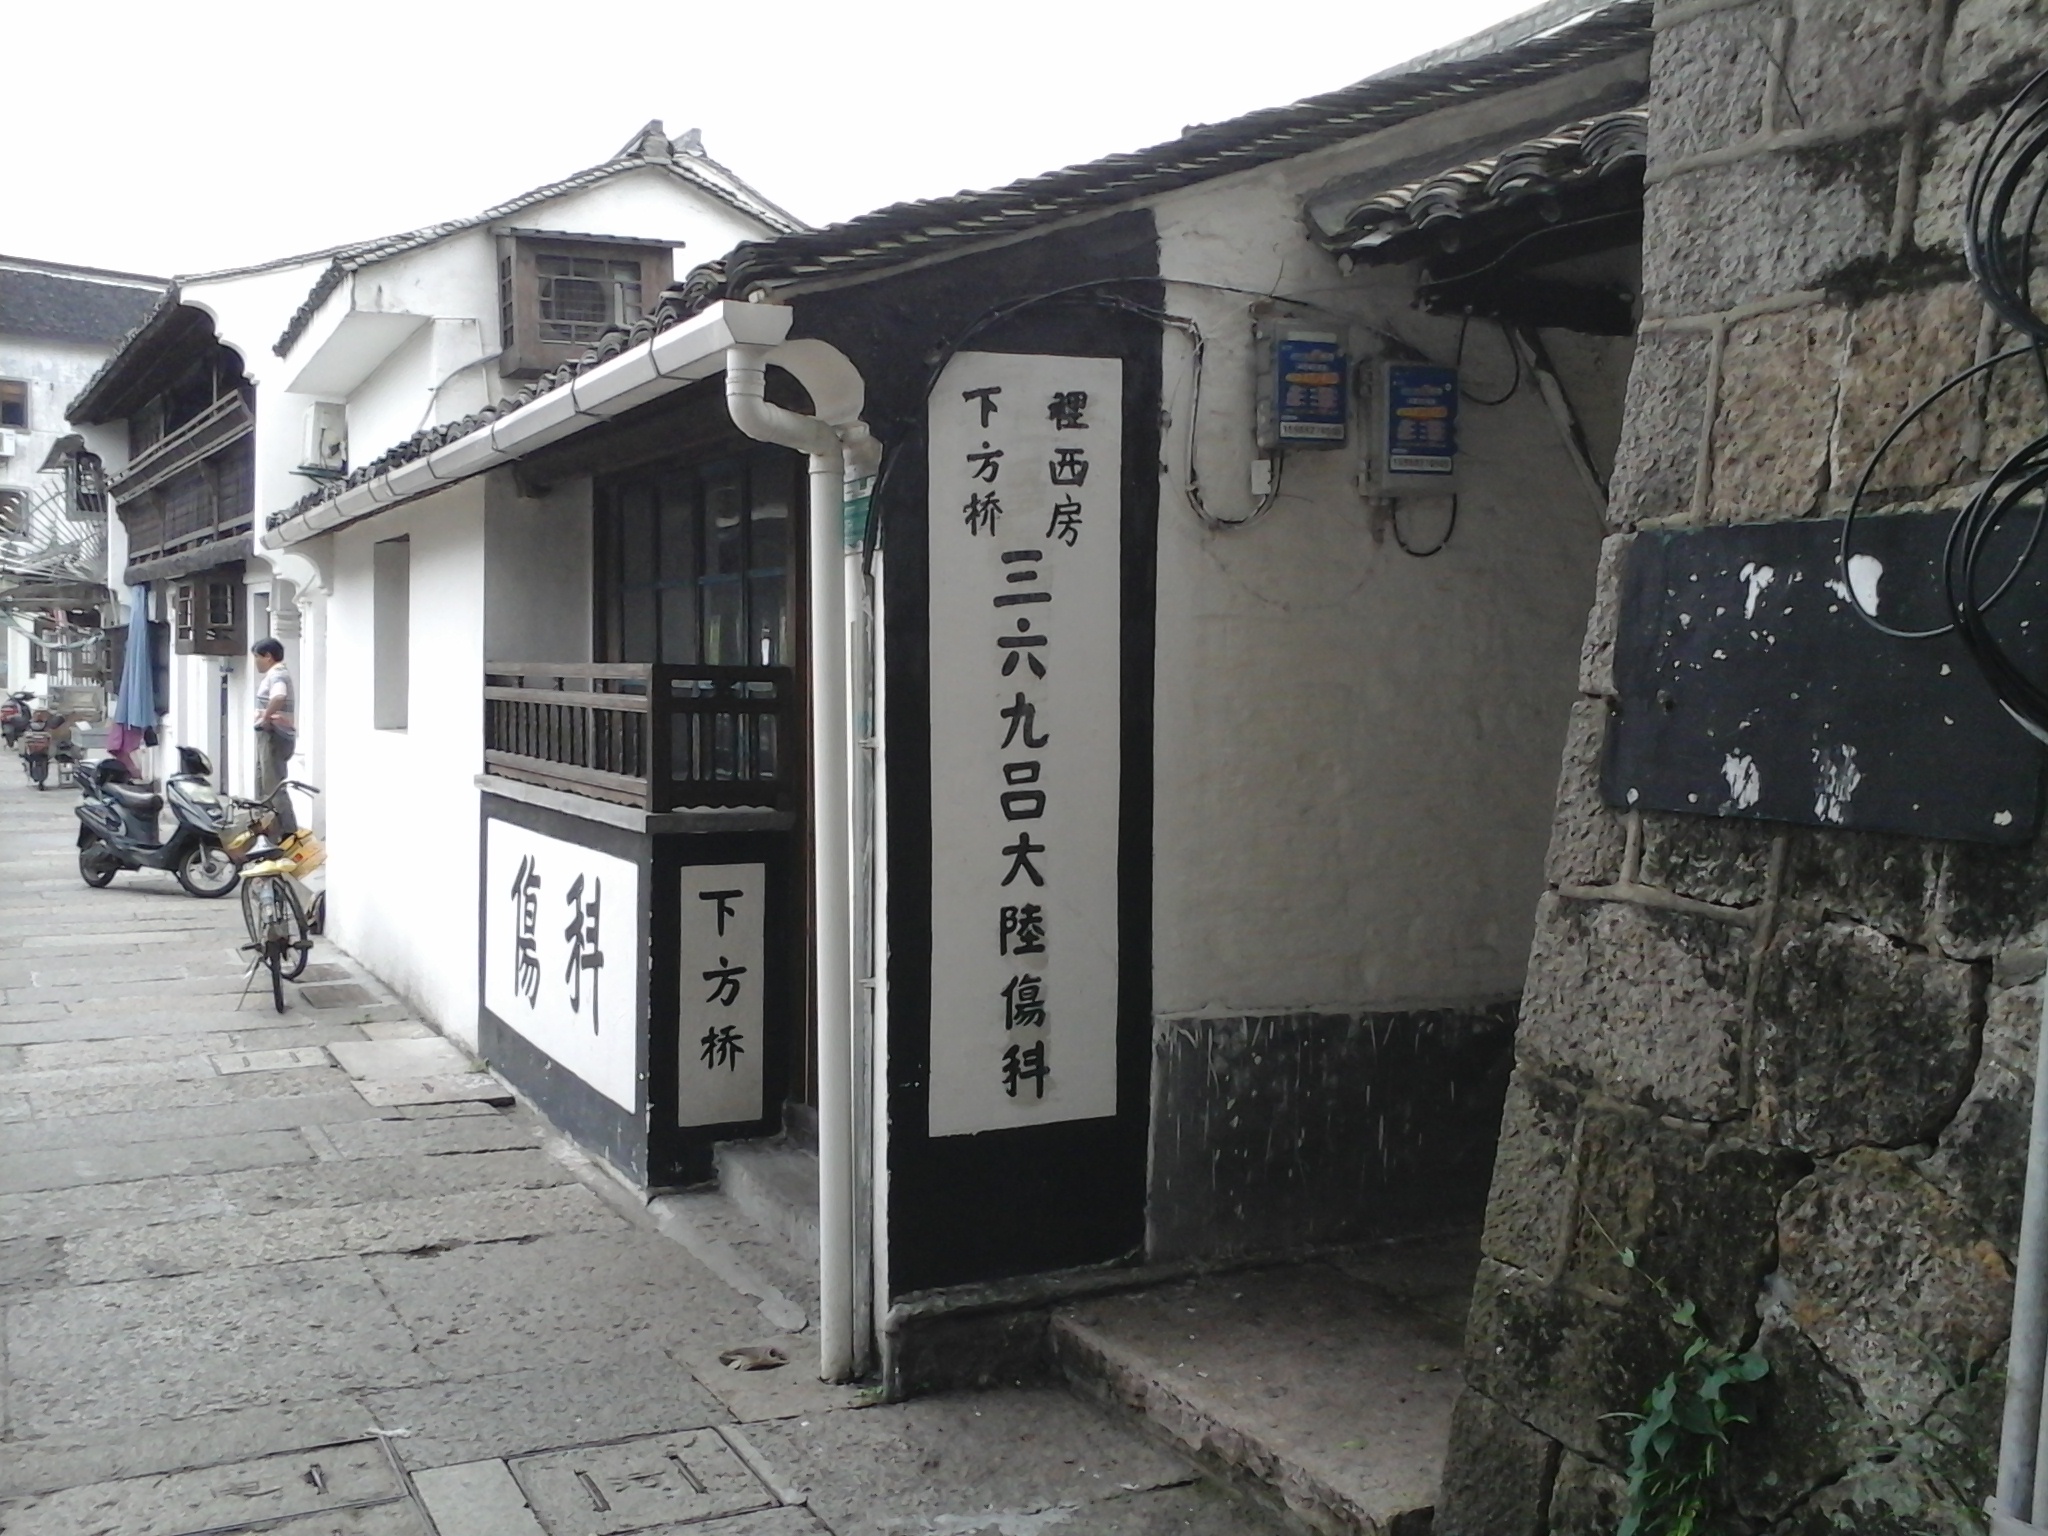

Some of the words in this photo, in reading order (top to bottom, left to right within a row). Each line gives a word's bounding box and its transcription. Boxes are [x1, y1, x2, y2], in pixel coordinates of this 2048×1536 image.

[962, 385, 1004, 537] 下方桥
[699, 889, 748, 1072] 下方桥
